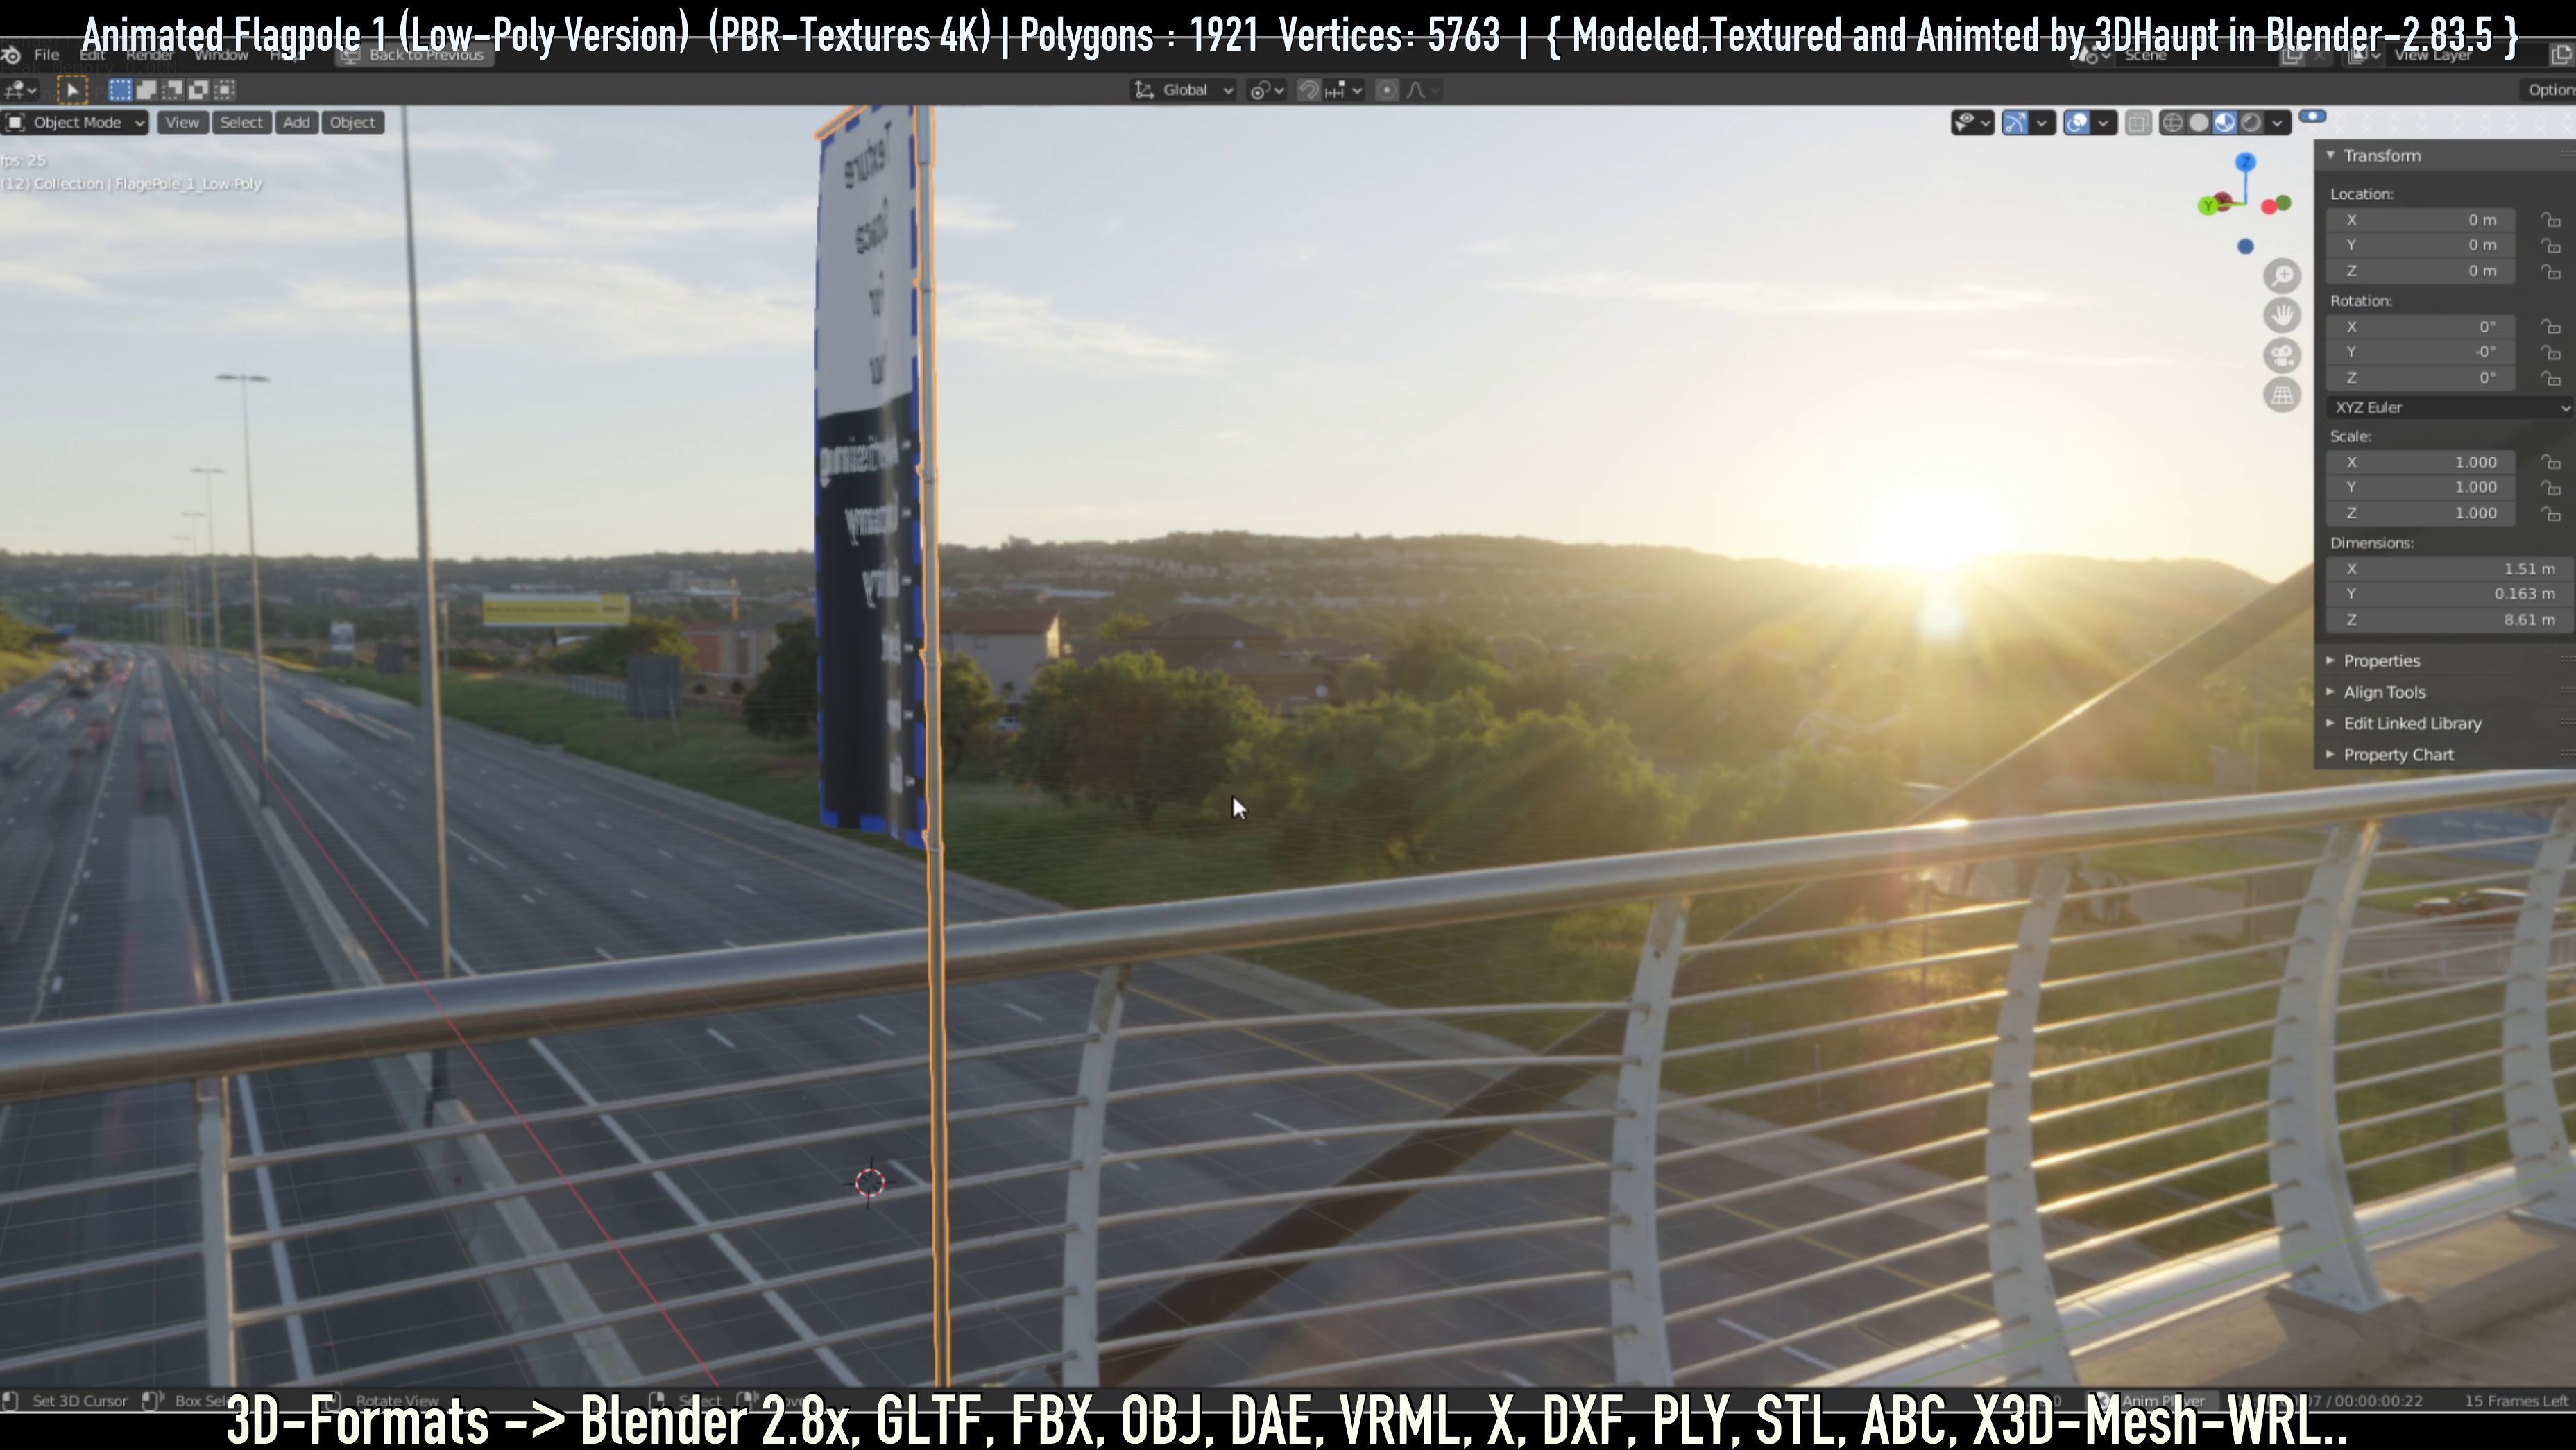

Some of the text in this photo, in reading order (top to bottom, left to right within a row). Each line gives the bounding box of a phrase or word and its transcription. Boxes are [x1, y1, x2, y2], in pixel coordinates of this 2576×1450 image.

[35, 49, 60, 61] File
[80, 49, 106, 61] Edit
[126, 49, 176, 61] Render
[195, 49, 249, 61] Window
[270, 49, 301, 64] Hp
[370, 49, 484, 61] Back to Previous
[2125, 49, 2167, 61] Scene
[2394, 49, 2473, 64] View Layer
[1163, 83, 1207, 96] Global
[34, 116, 121, 131] Object Mode
[165, 116, 200, 128] View
[221, 116, 264, 128] Select
[283, 116, 311, 128] Add
[330, 116, 376, 131] Object
[0, 153, 49, 169] fps: 25
[2344, 148, 2421, 162] Transform
[0, 178, 31, 192] (12)
[33, 177, 104, 190] Collection
[115, 176, 262, 193] FlagePole_1_Low-Poly
[2331, 188, 2394, 200] Location:
[2347, 214, 2497, 226] X 0 m
[2347, 239, 2497, 251] Y 0 m
[2347, 264, 2497, 277] Z 0 m
[2331, 295, 2393, 307] Rotation:
[2347, 321, 2496, 333] X 0°
[2346, 345, 2496, 358] Y -0°
[2347, 371, 2496, 384] Z 0°
[2337, 401, 2403, 413] XYZ Euler
[2331, 429, 2371, 443] Scale:
[2347, 456, 2497, 468] X 1.000
[2346, 481, 2497, 493] Y 1.000
[2347, 506, 2497, 519] Z 1.000
[2331, 536, 2414, 549] Dimensions:
[2347, 563, 2556, 575] X 1.51 m
[2346, 588, 2556, 600] Y 0.163 m
[2347, 613, 2556, 626] Z 8.61 m
[2345, 654, 2421, 670] Properties
[2344, 685, 2427, 702] Align Tools
[2345, 717, 2482, 733] Edit Linked Library
[2345, 748, 2455, 765] Property Chart
[33, 1395, 128, 1407] Set 3D Cursor
[176, 1395, 201, 1407] Box
[357, 1395, 439, 1407] Rotate View
[679, 1395, 722, 1407] Seect
[2123, 1395, 2206, 1408] Anim Plyer
[2335, 1394, 2423, 1407] 00:00:00:22
[2466, 1395, 2568, 1407] 15 Frames Left
